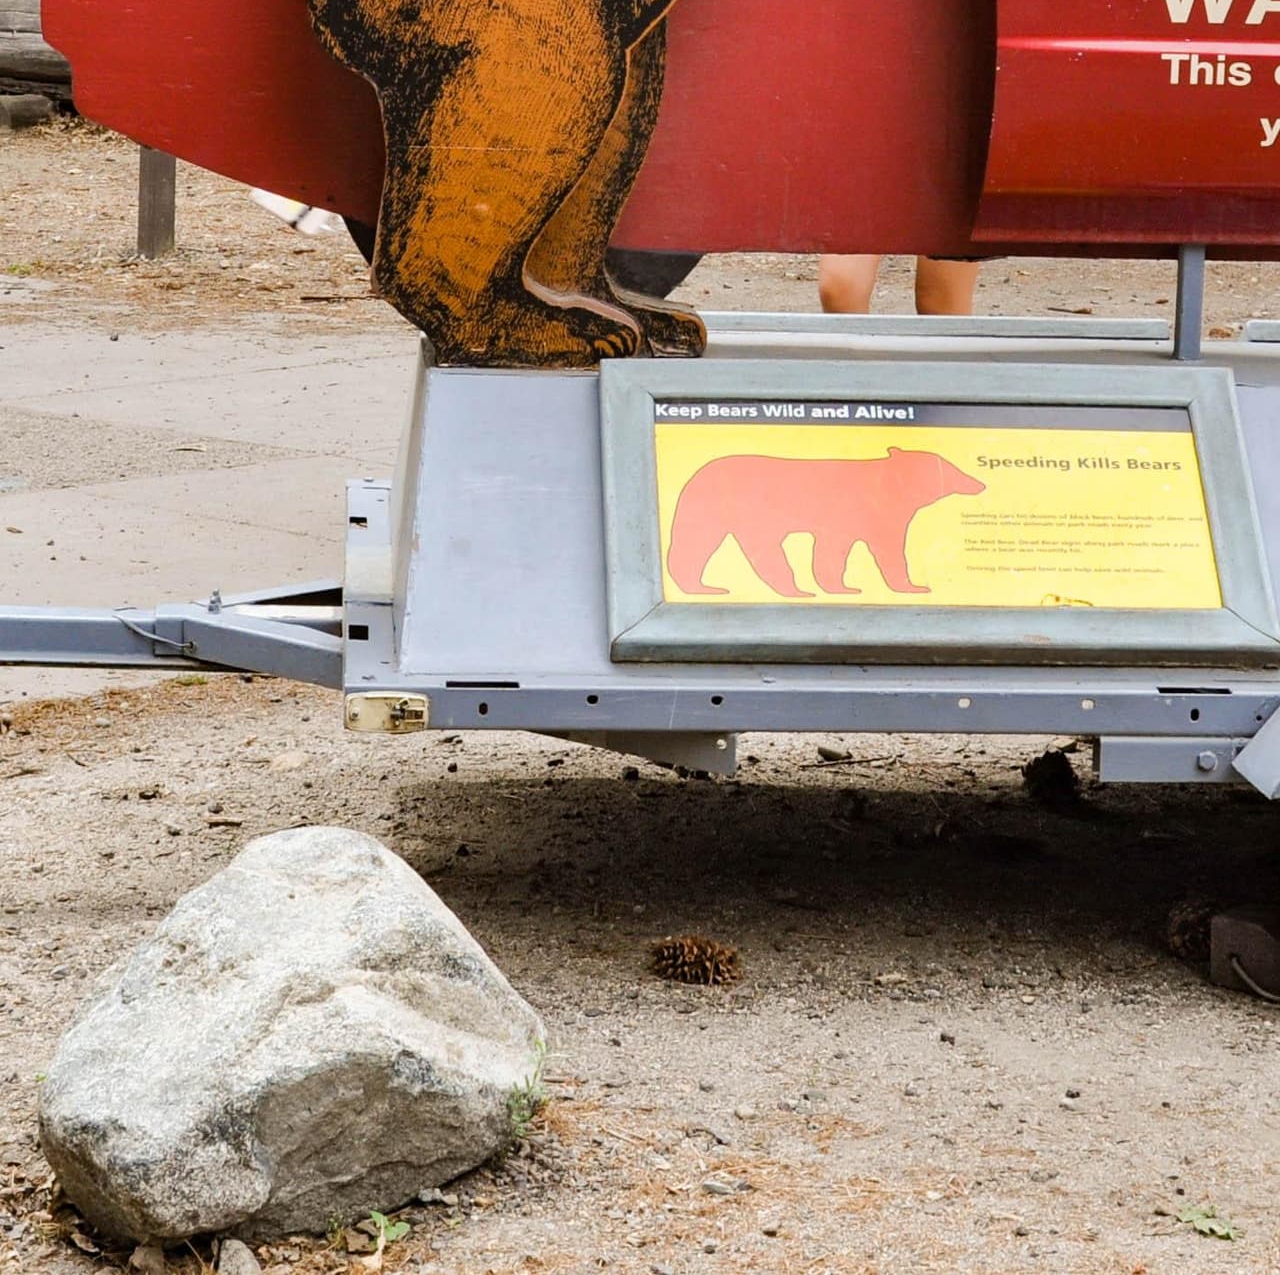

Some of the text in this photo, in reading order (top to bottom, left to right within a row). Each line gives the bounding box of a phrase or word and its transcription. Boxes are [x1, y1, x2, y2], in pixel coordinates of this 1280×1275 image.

[1161, 53, 1252, 87] This
[655, 404, 914, 420] Keep Bears Wild and Alive!
[976, 455, 1182, 472] Speeding Kills Bears
